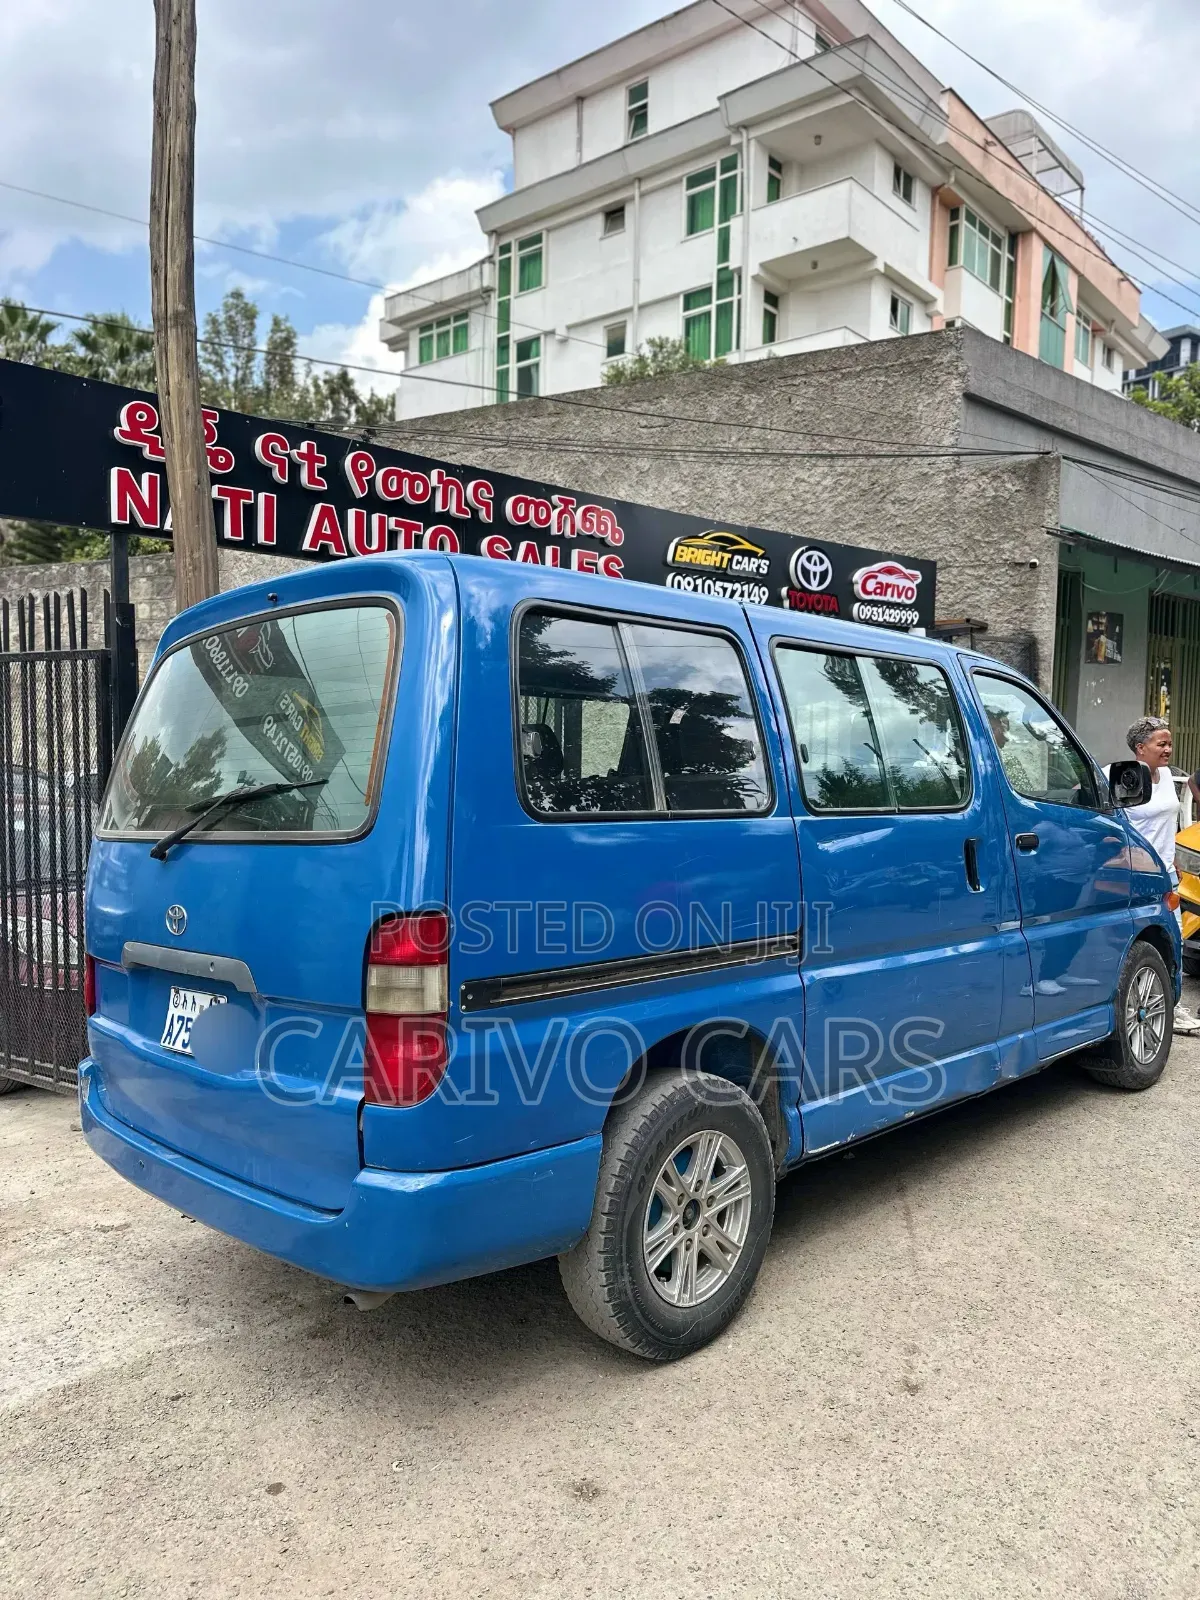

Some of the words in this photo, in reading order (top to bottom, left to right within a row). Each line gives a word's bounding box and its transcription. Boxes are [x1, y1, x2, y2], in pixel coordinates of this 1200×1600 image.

[255, 432, 327, 491] ናቲ
[344, 450, 494, 523] የመኪና
[505, 494, 625, 546] መሸጫ
[110, 467, 277, 546] NTI
[303, 503, 461, 557] AUTO
[674, 545, 732, 568] BRIGHT
[731, 555, 770, 574] CAR'S
[673, 574, 769, 605] 0910572149
[788, 590, 839, 613] TOYOTA
[860, 574, 916, 601] Carivo
[859, 604, 920, 626] 0931429999
